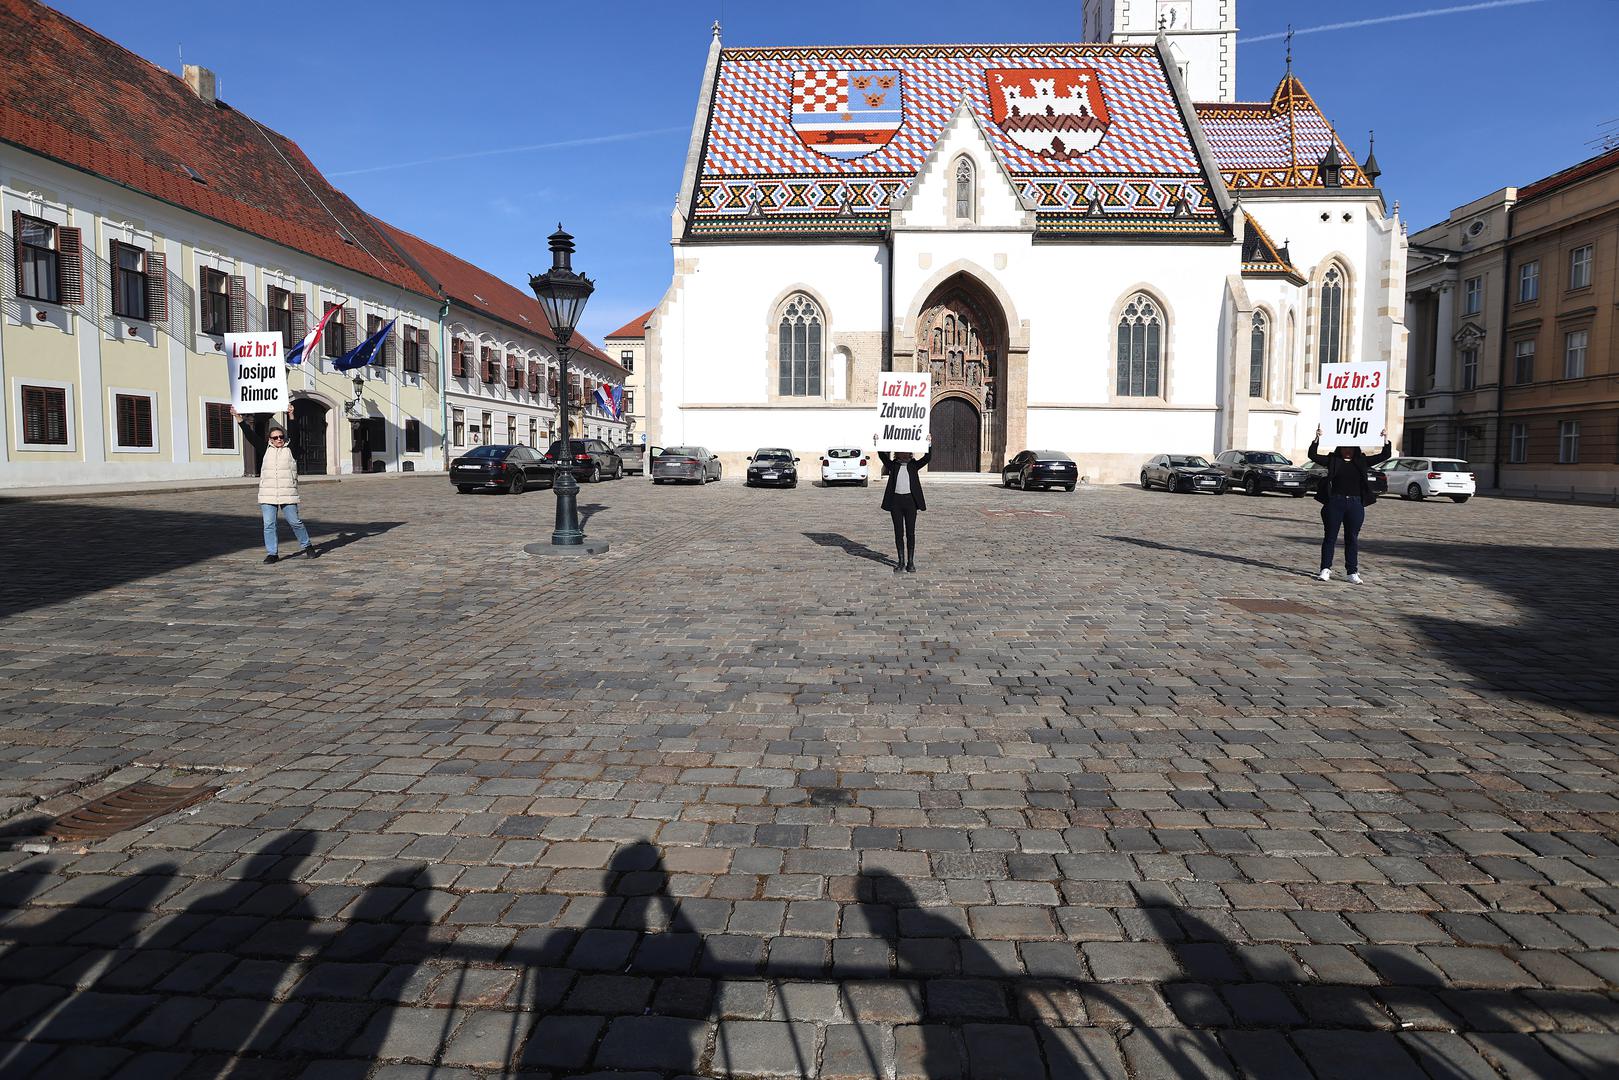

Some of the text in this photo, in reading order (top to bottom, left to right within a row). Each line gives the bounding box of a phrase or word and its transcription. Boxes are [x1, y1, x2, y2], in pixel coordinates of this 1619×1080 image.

[232, 340, 277, 358] Laž br.1
[238, 363, 276, 382] Josipa
[1326, 371, 1381, 389] Laž br.3
[241, 385, 279, 402] Rimac
[882, 380, 927, 397] Laž br.2
[880, 402, 927, 419] Zdravko
[1331, 393, 1375, 412] bratić
[883, 424, 923, 441] Mamić
[1336, 417, 1369, 438] Vrlja
